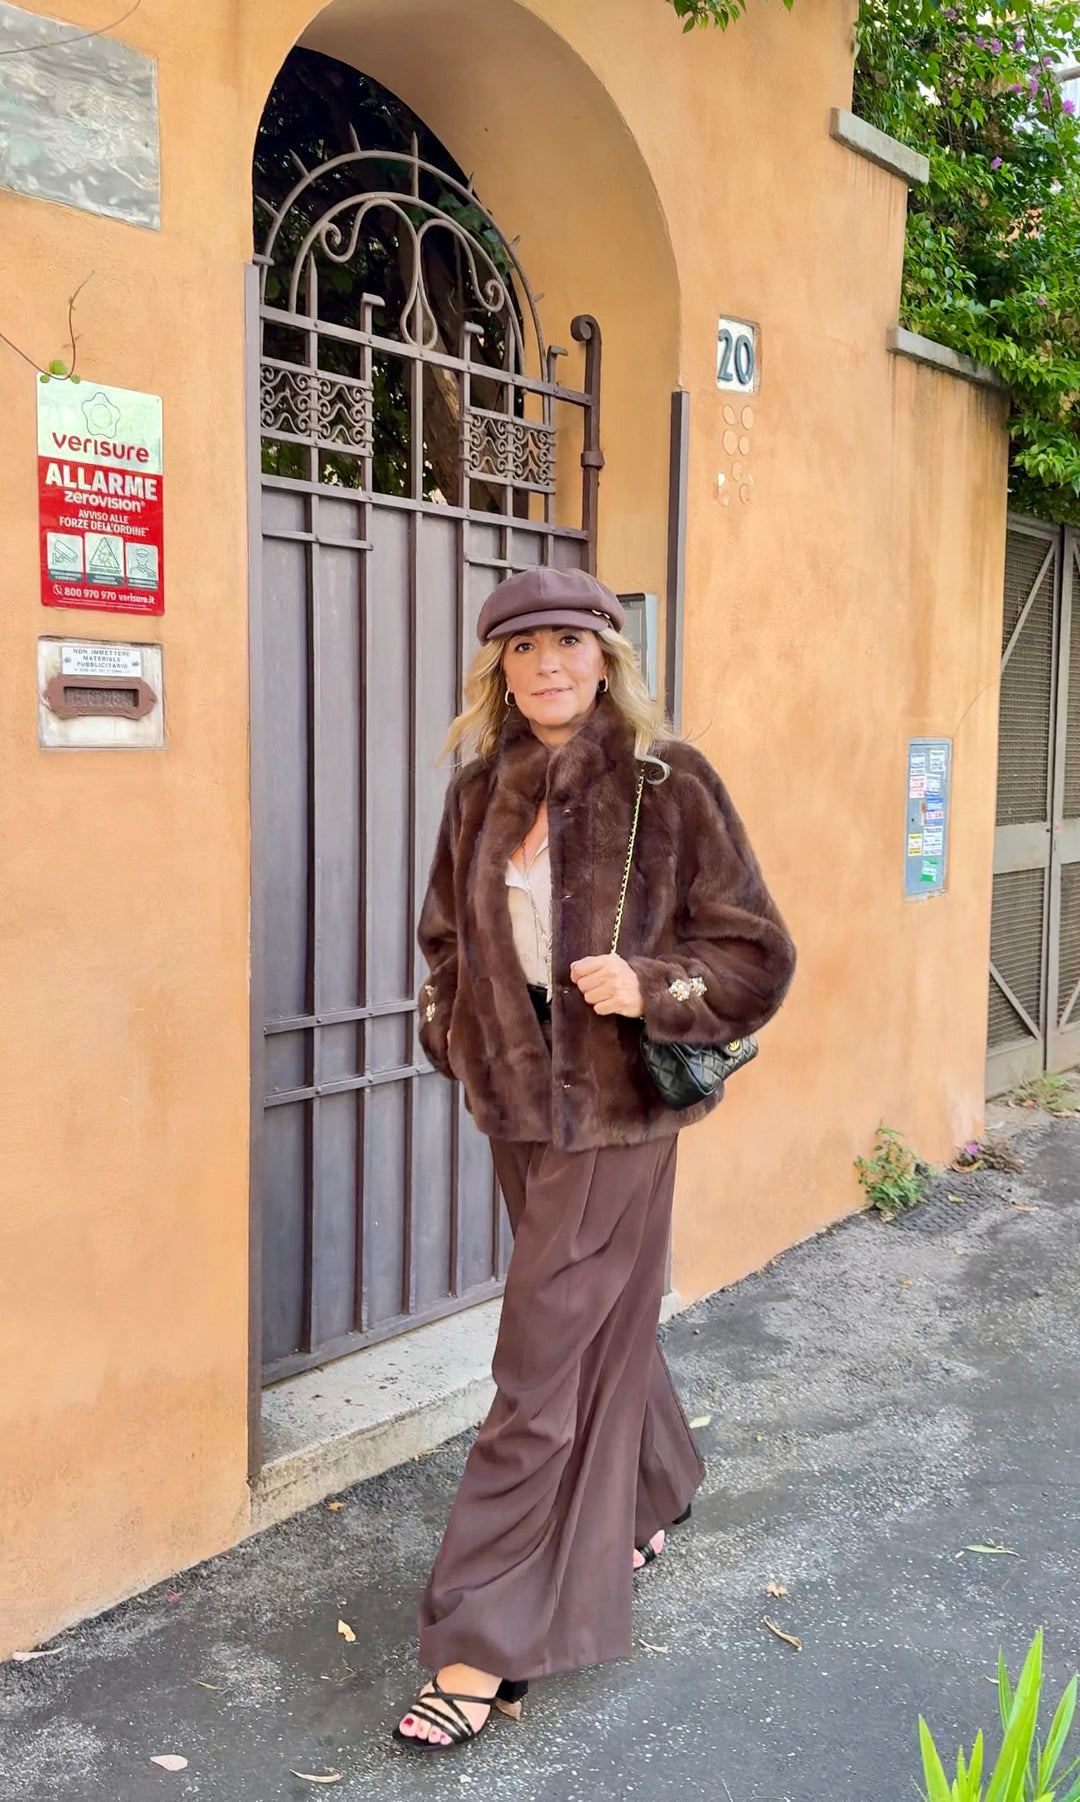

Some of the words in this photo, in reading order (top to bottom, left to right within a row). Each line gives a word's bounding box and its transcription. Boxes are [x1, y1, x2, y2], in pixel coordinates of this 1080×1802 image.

[718, 329, 754, 385] 20
[52, 432, 149, 463] verisure
[45, 462, 158, 501] ALLARME
[59, 516, 89, 529] FORZE
[78, 509, 109, 521] AVVISO
[109, 514, 129, 524] ALLE
[64, 587, 82, 597] 800
[83, 589, 100, 598] 970
[100, 590, 117, 600] 970
